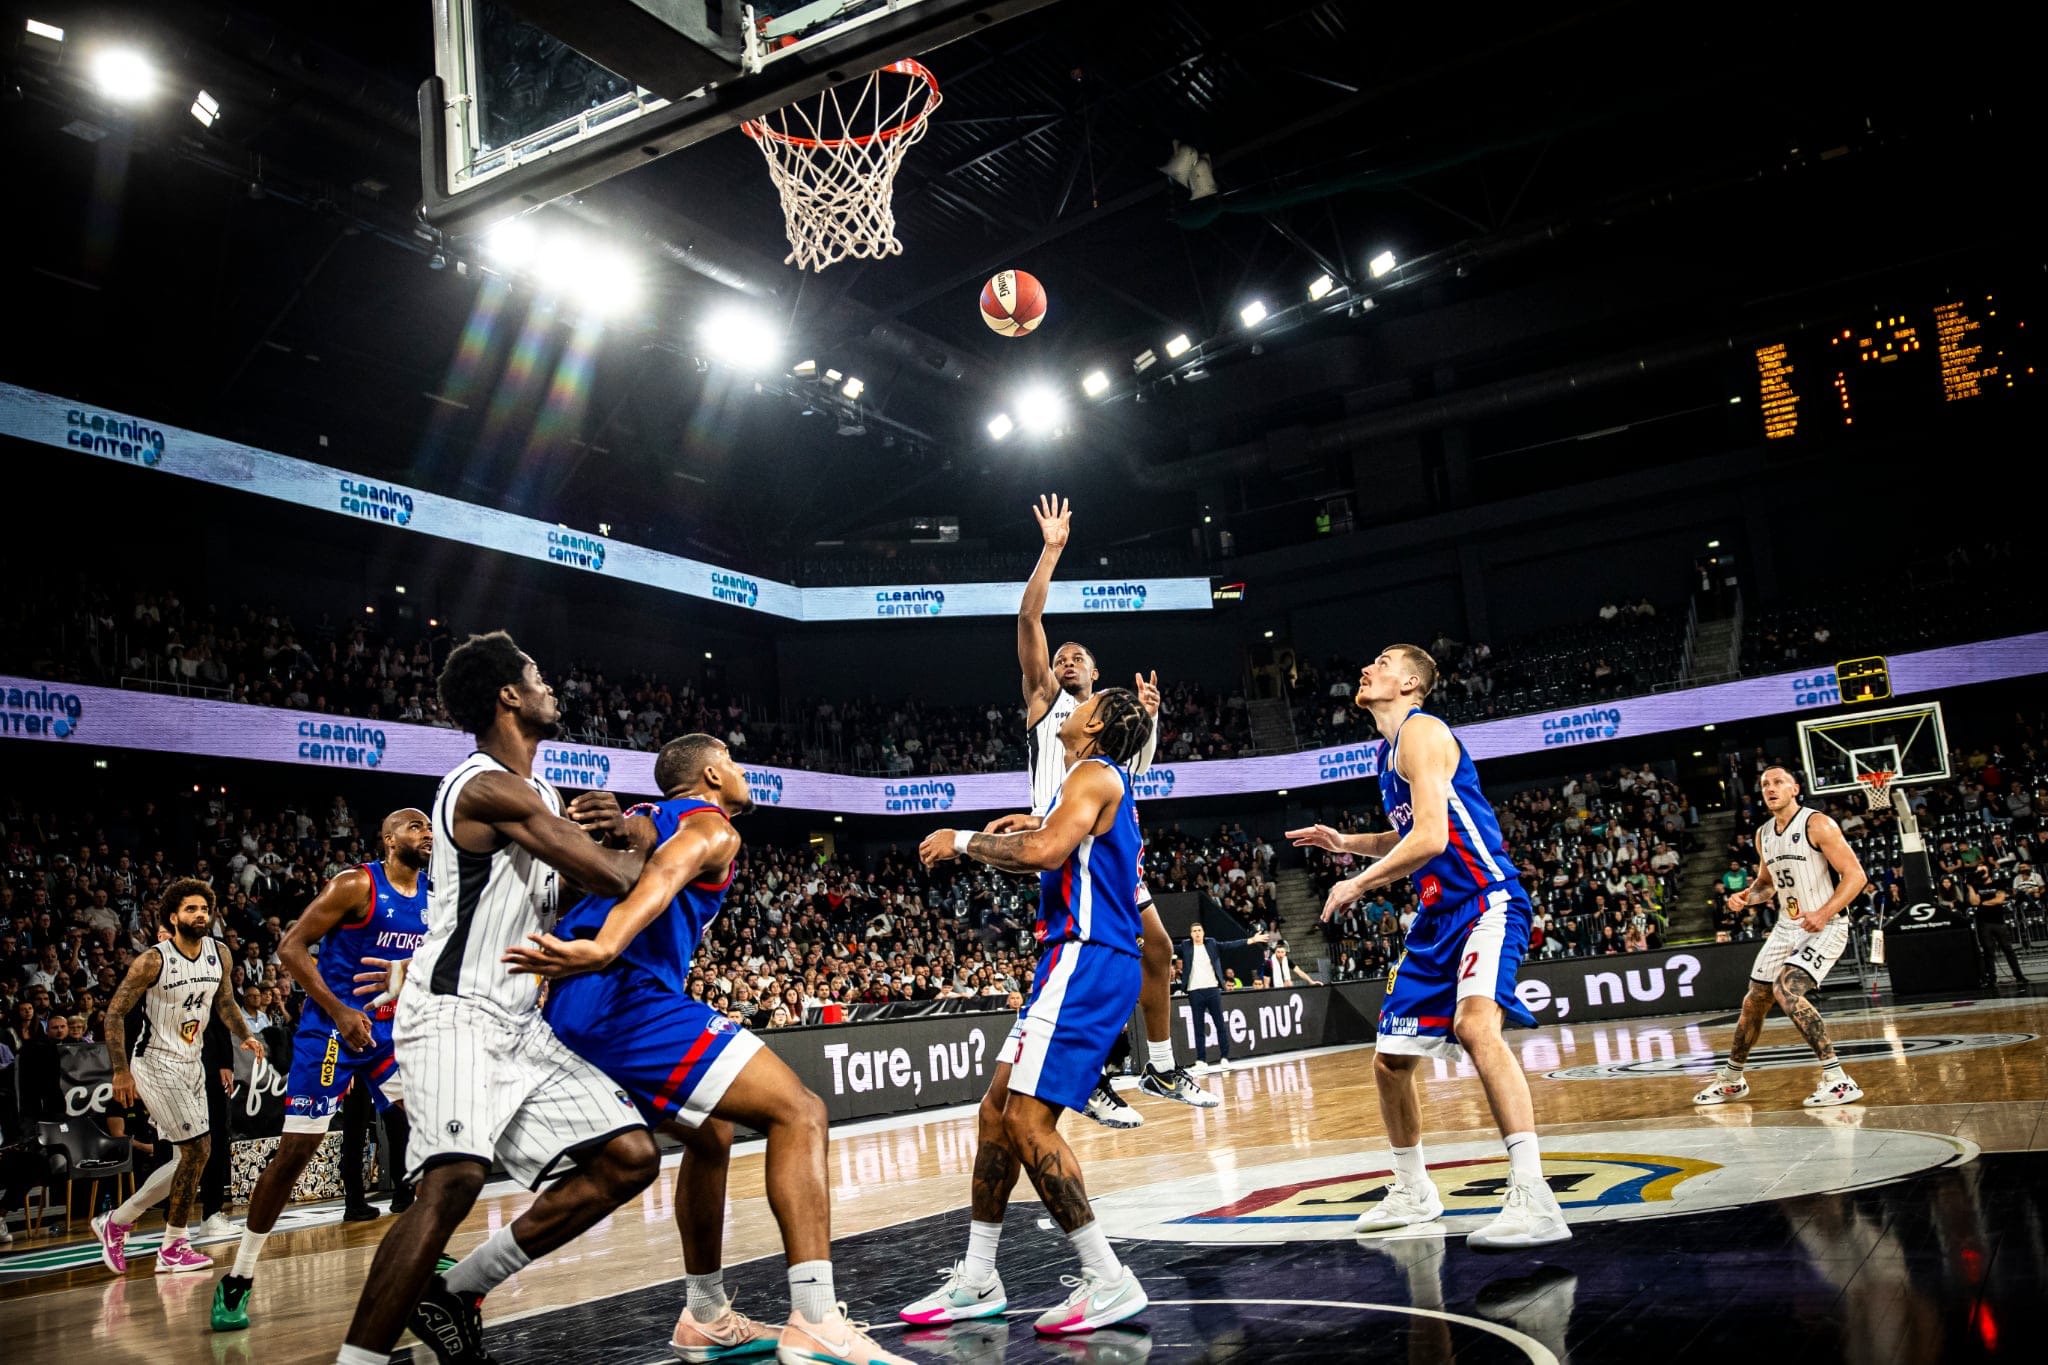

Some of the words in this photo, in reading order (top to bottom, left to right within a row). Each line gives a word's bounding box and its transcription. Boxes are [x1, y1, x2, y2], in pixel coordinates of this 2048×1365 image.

[182, 991, 206, 1012] 44
[1584, 954, 1701, 1006] nu?
[1259, 993, 1303, 1039] nu?
[1392, 1016, 1419, 1027] NOVA
[824, 1043, 922, 1096] Tare,
[928, 1028, 986, 1082] nu?
